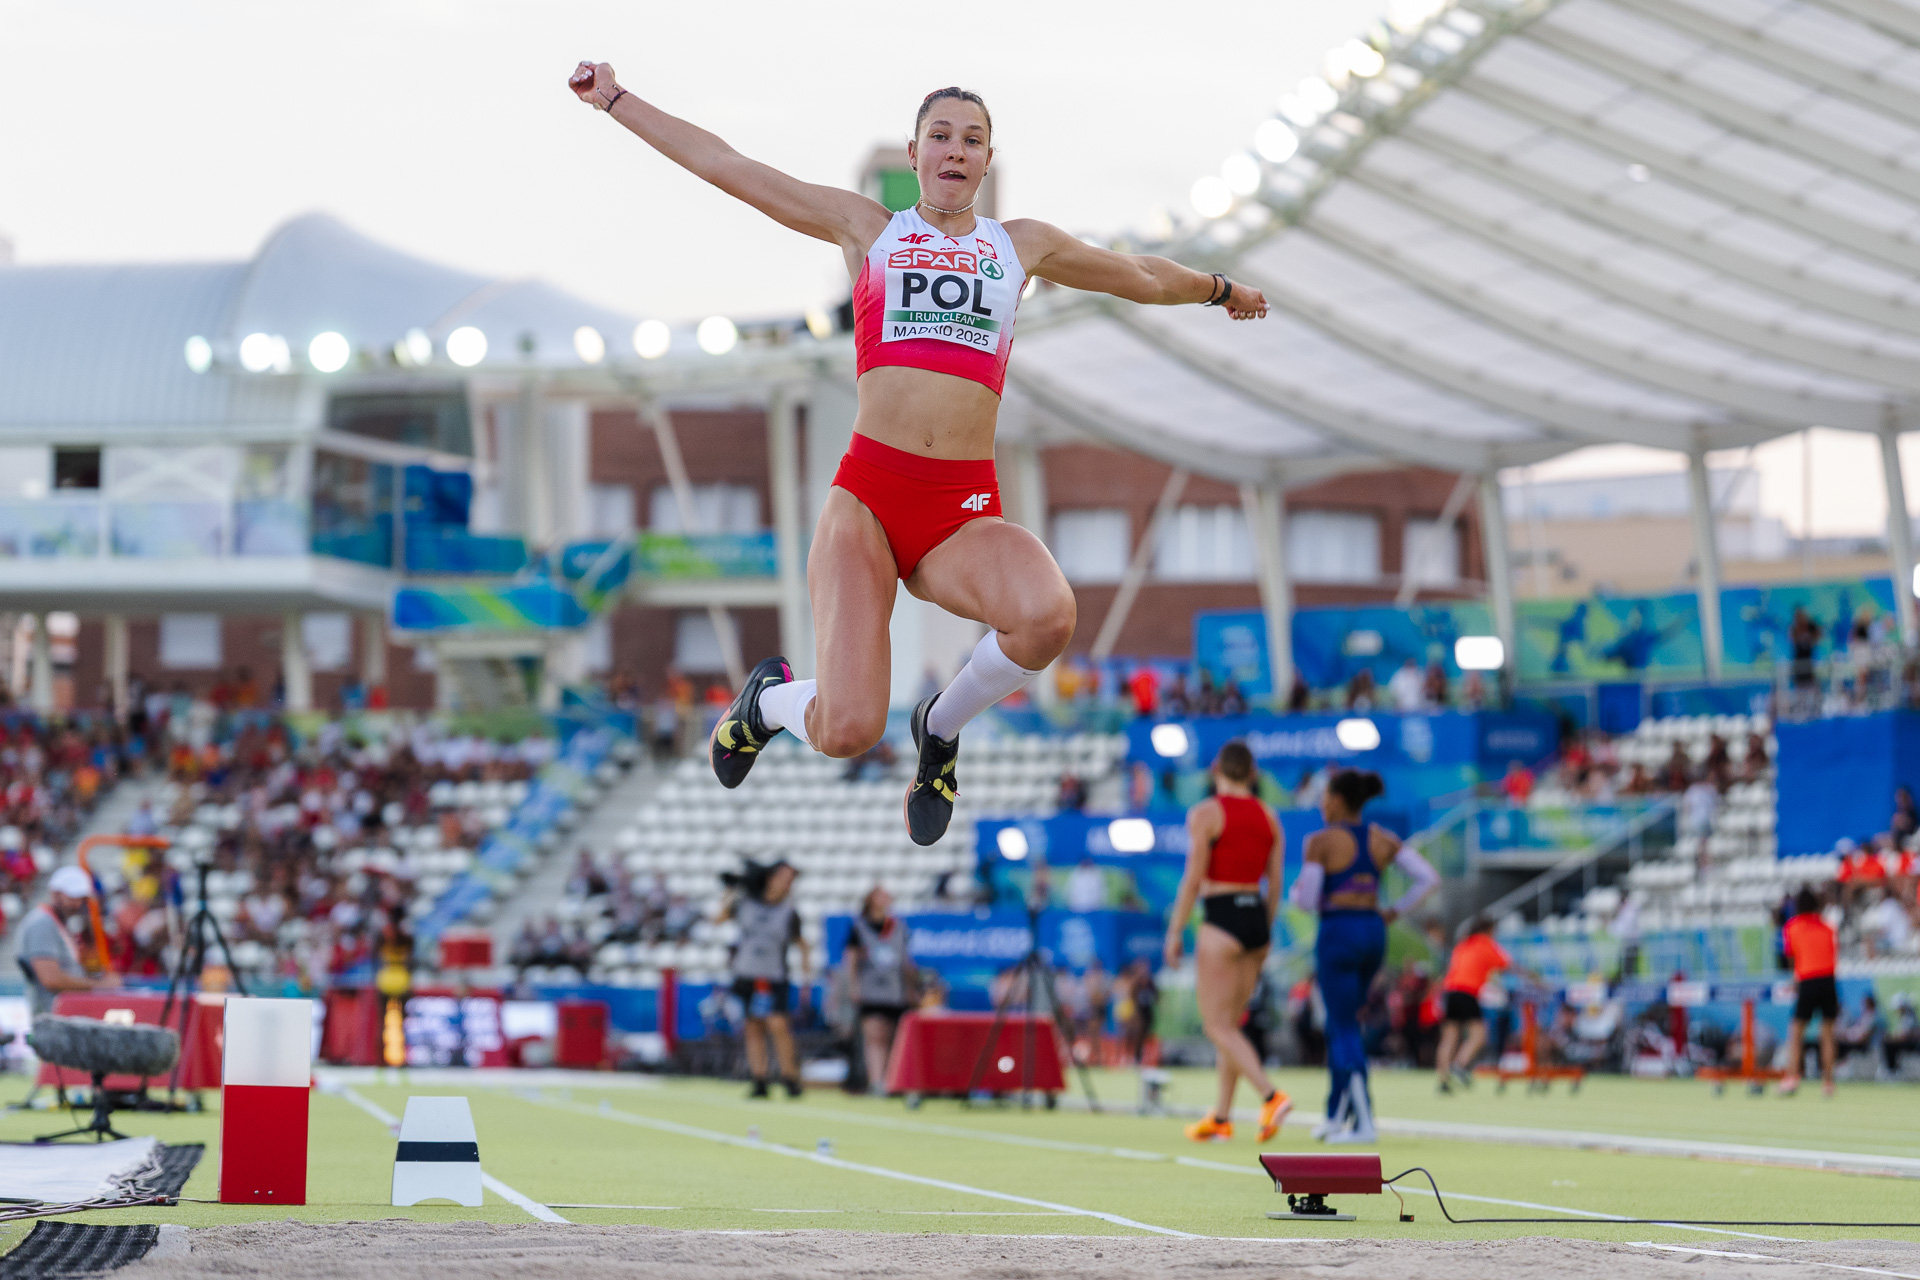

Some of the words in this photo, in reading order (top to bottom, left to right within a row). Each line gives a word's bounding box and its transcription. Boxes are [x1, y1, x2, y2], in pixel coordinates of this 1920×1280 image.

[891, 251, 975, 271] SPAR
[902, 272, 992, 316] POL
[909, 312, 913, 321] I
[915, 312, 940, 322] RUN
[955, 328, 990, 347] 2025
[961, 493, 992, 511] 4F
